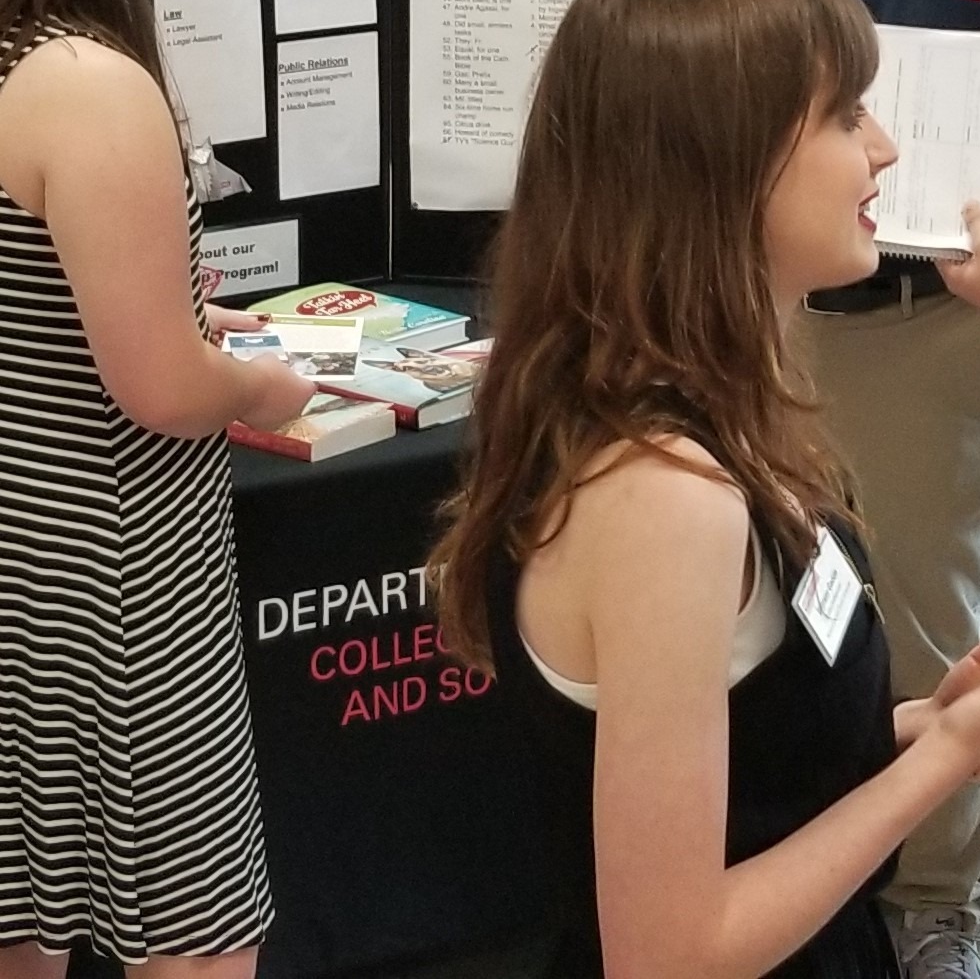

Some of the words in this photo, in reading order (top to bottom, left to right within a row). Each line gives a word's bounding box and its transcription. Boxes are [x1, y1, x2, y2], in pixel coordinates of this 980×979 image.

[164, 9, 182, 21] Law
[172, 24, 195, 33] Lawyer
[173, 38, 191, 46] Legal
[278, 61, 305, 74] Public
[308, 57, 348, 71] Relations
[312, 72, 352, 82] Management
[232, 243, 255, 256] our
[258, 566, 428, 641] DEPART
[310, 624, 451, 681] COLLEC
[341, 676, 427, 726] AND
[439, 666, 492, 702] SO
